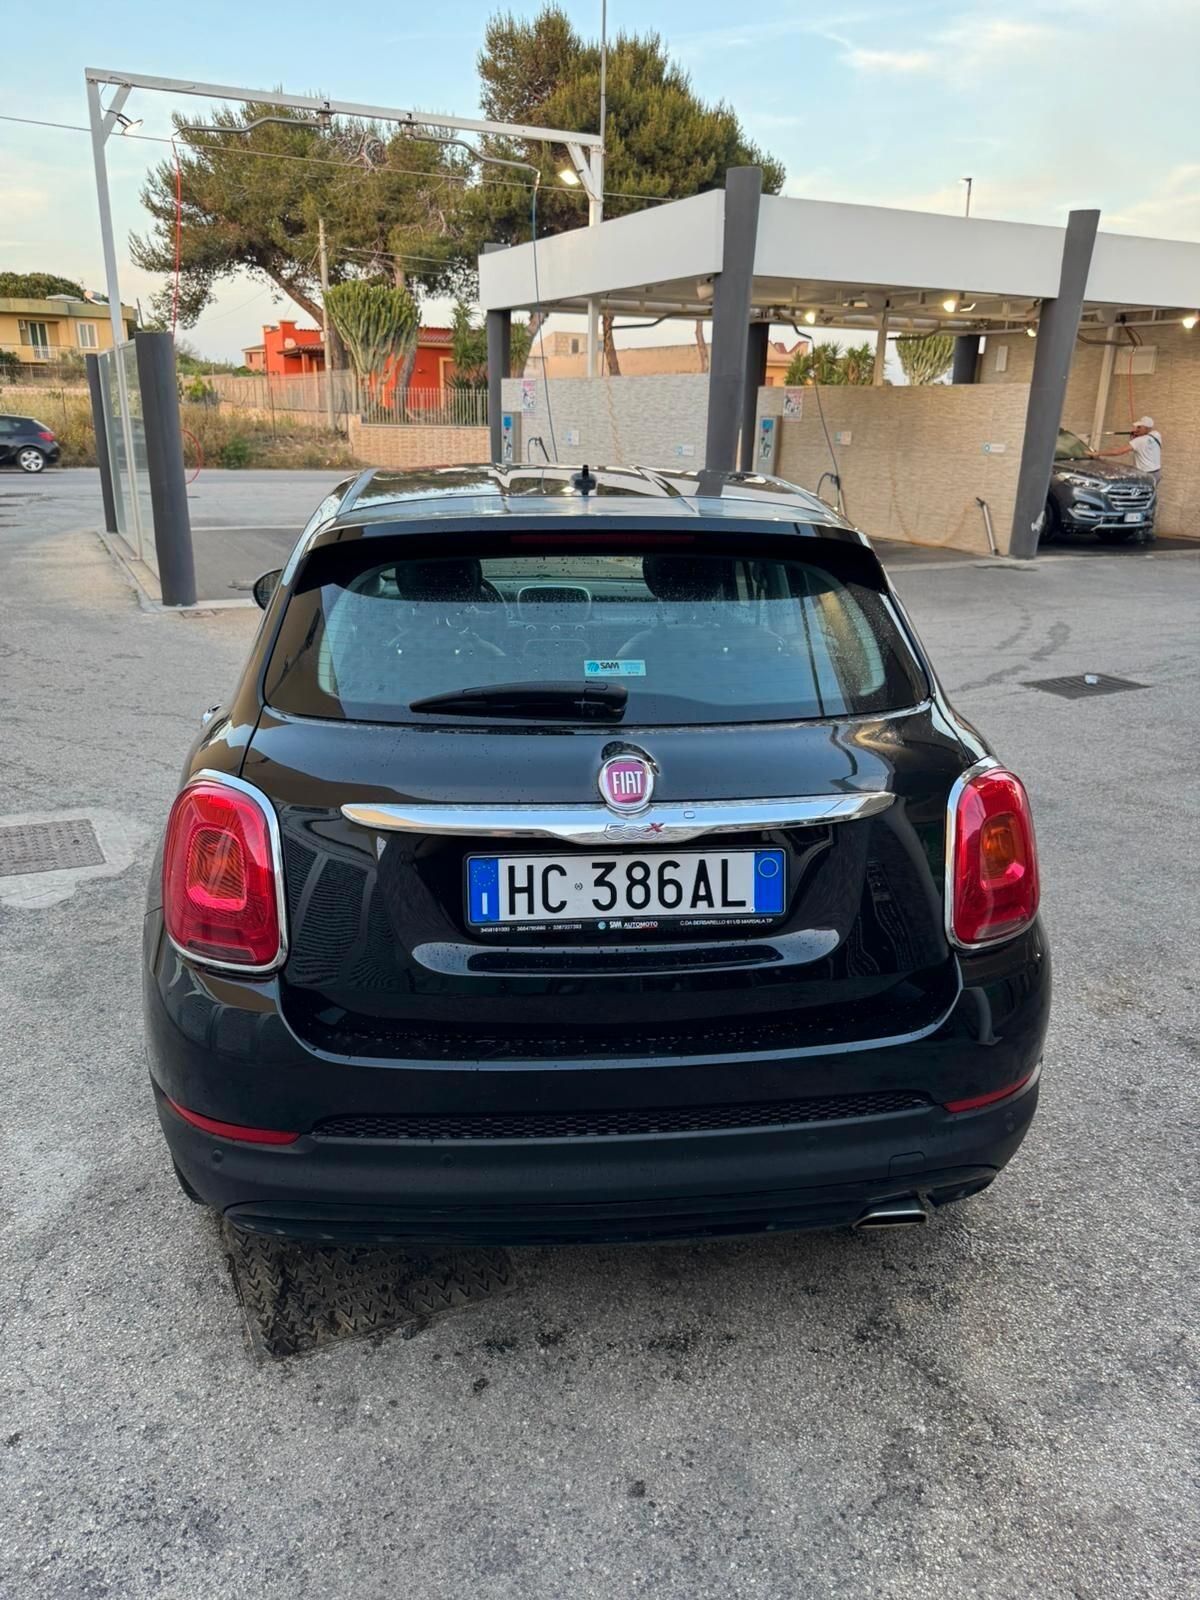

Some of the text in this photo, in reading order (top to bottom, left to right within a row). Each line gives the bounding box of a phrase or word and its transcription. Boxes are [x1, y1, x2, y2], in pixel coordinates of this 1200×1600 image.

[600, 662, 620, 670] SAM
[612, 771, 643, 794] FIAT
[508, 864, 567, 915] HC
[592, 859, 746, 912] 386AL
[624, 921, 658, 929] AUTOMOTO
